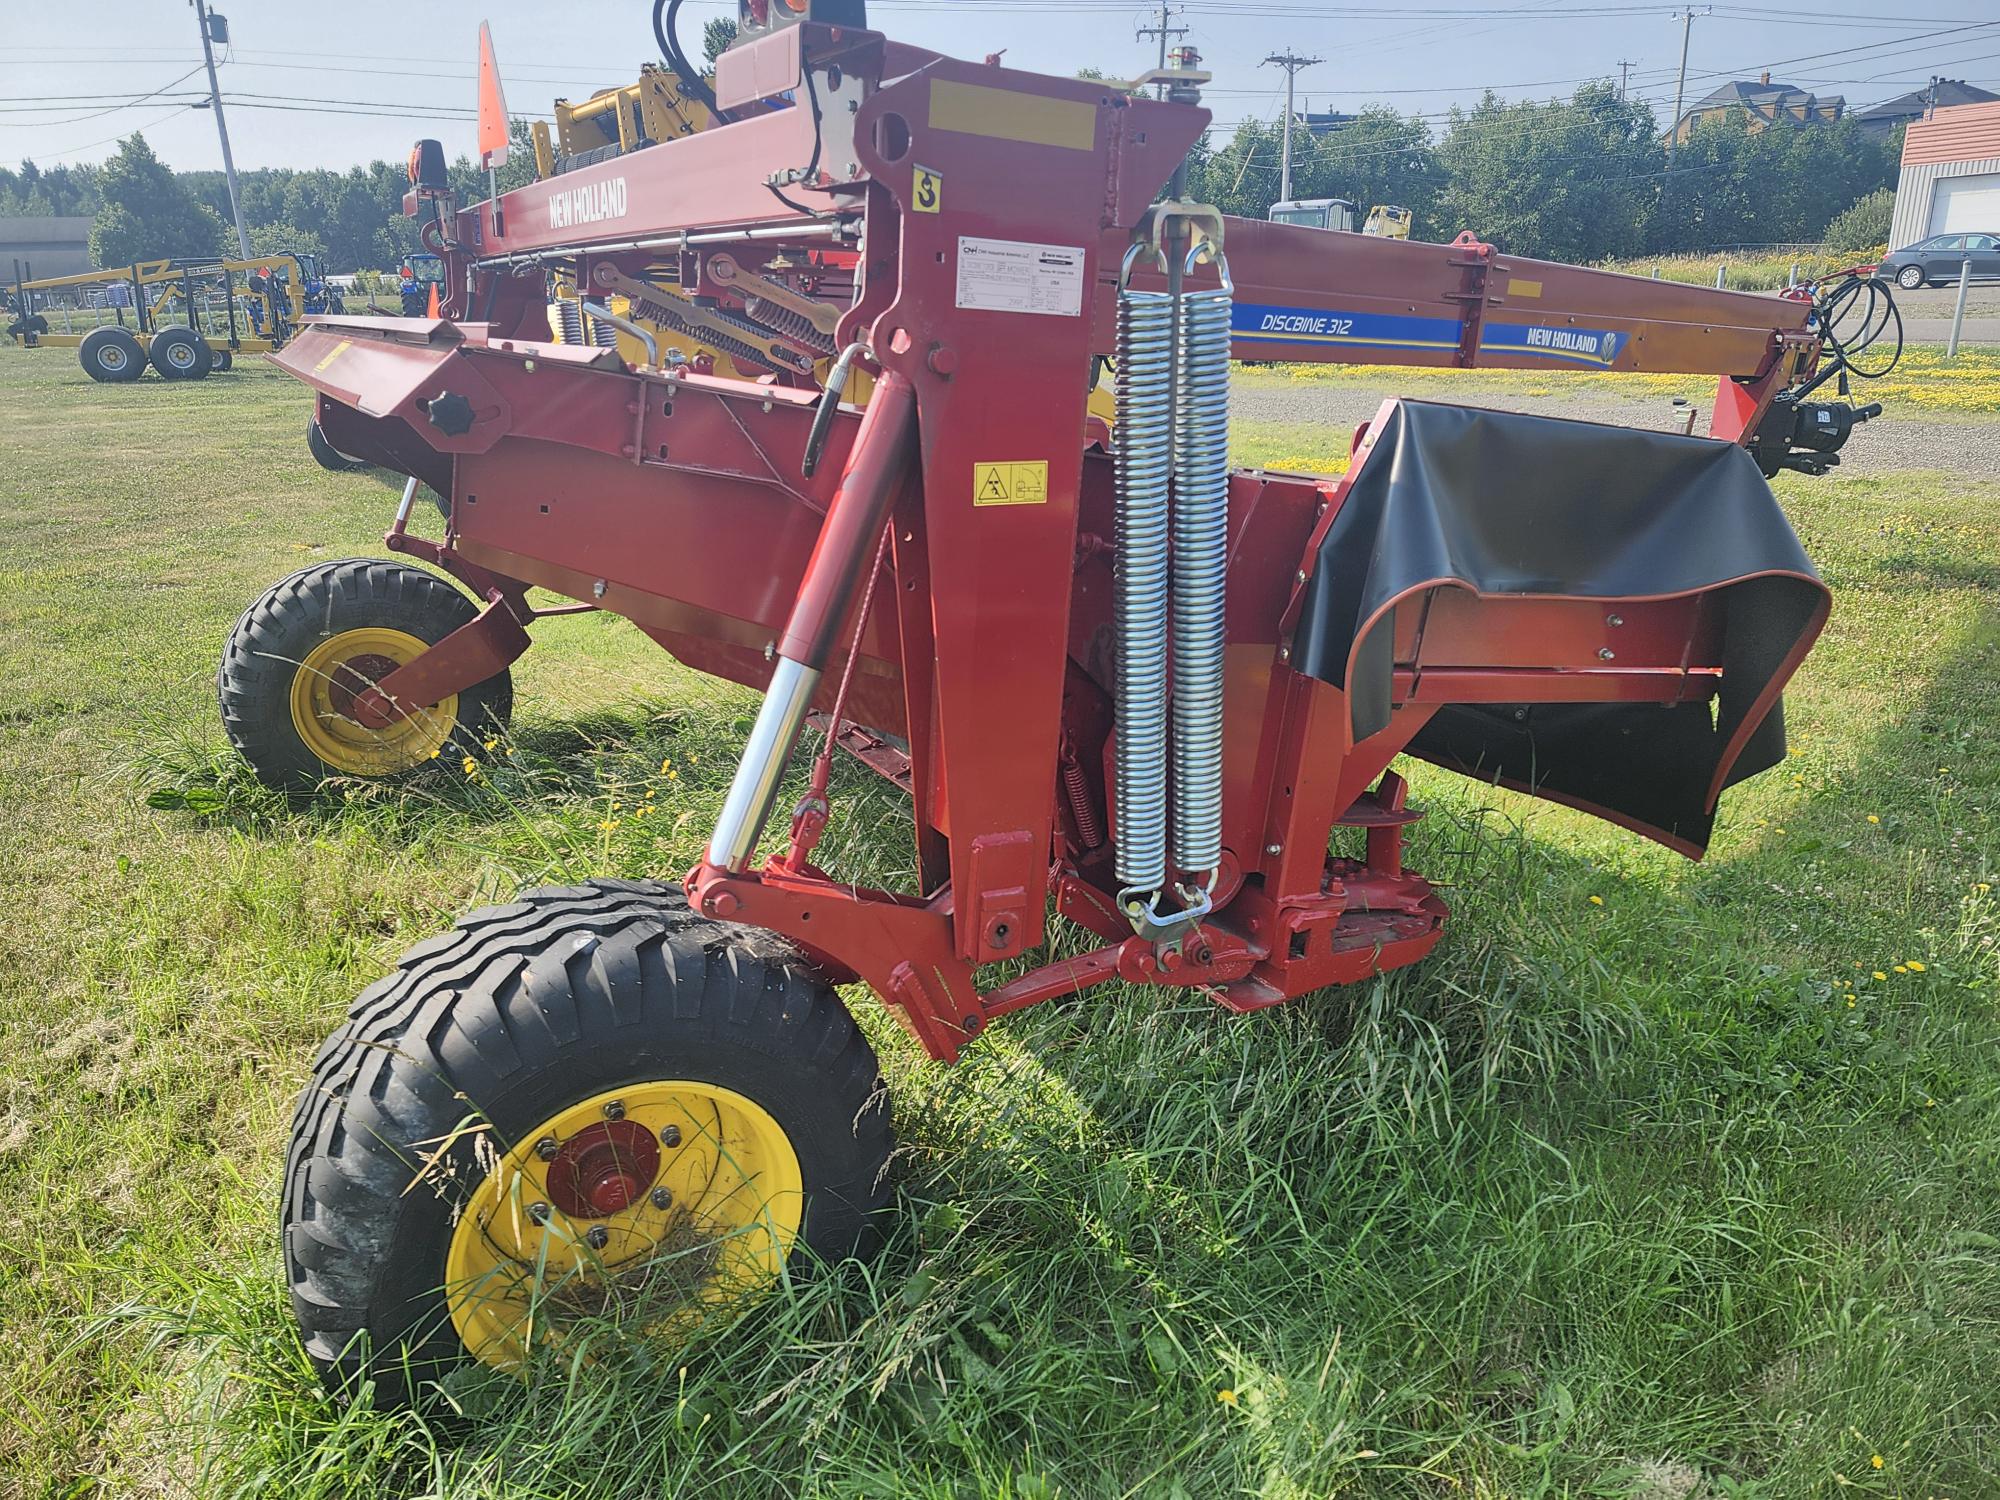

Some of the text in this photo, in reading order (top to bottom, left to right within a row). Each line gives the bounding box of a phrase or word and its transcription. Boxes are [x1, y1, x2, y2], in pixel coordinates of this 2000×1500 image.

[550, 177, 627, 229] NEW HOLLAND
[1261, 314, 1353, 335] DISCBINE 312
[1527, 328, 1597, 353] NEW HOLLAND
